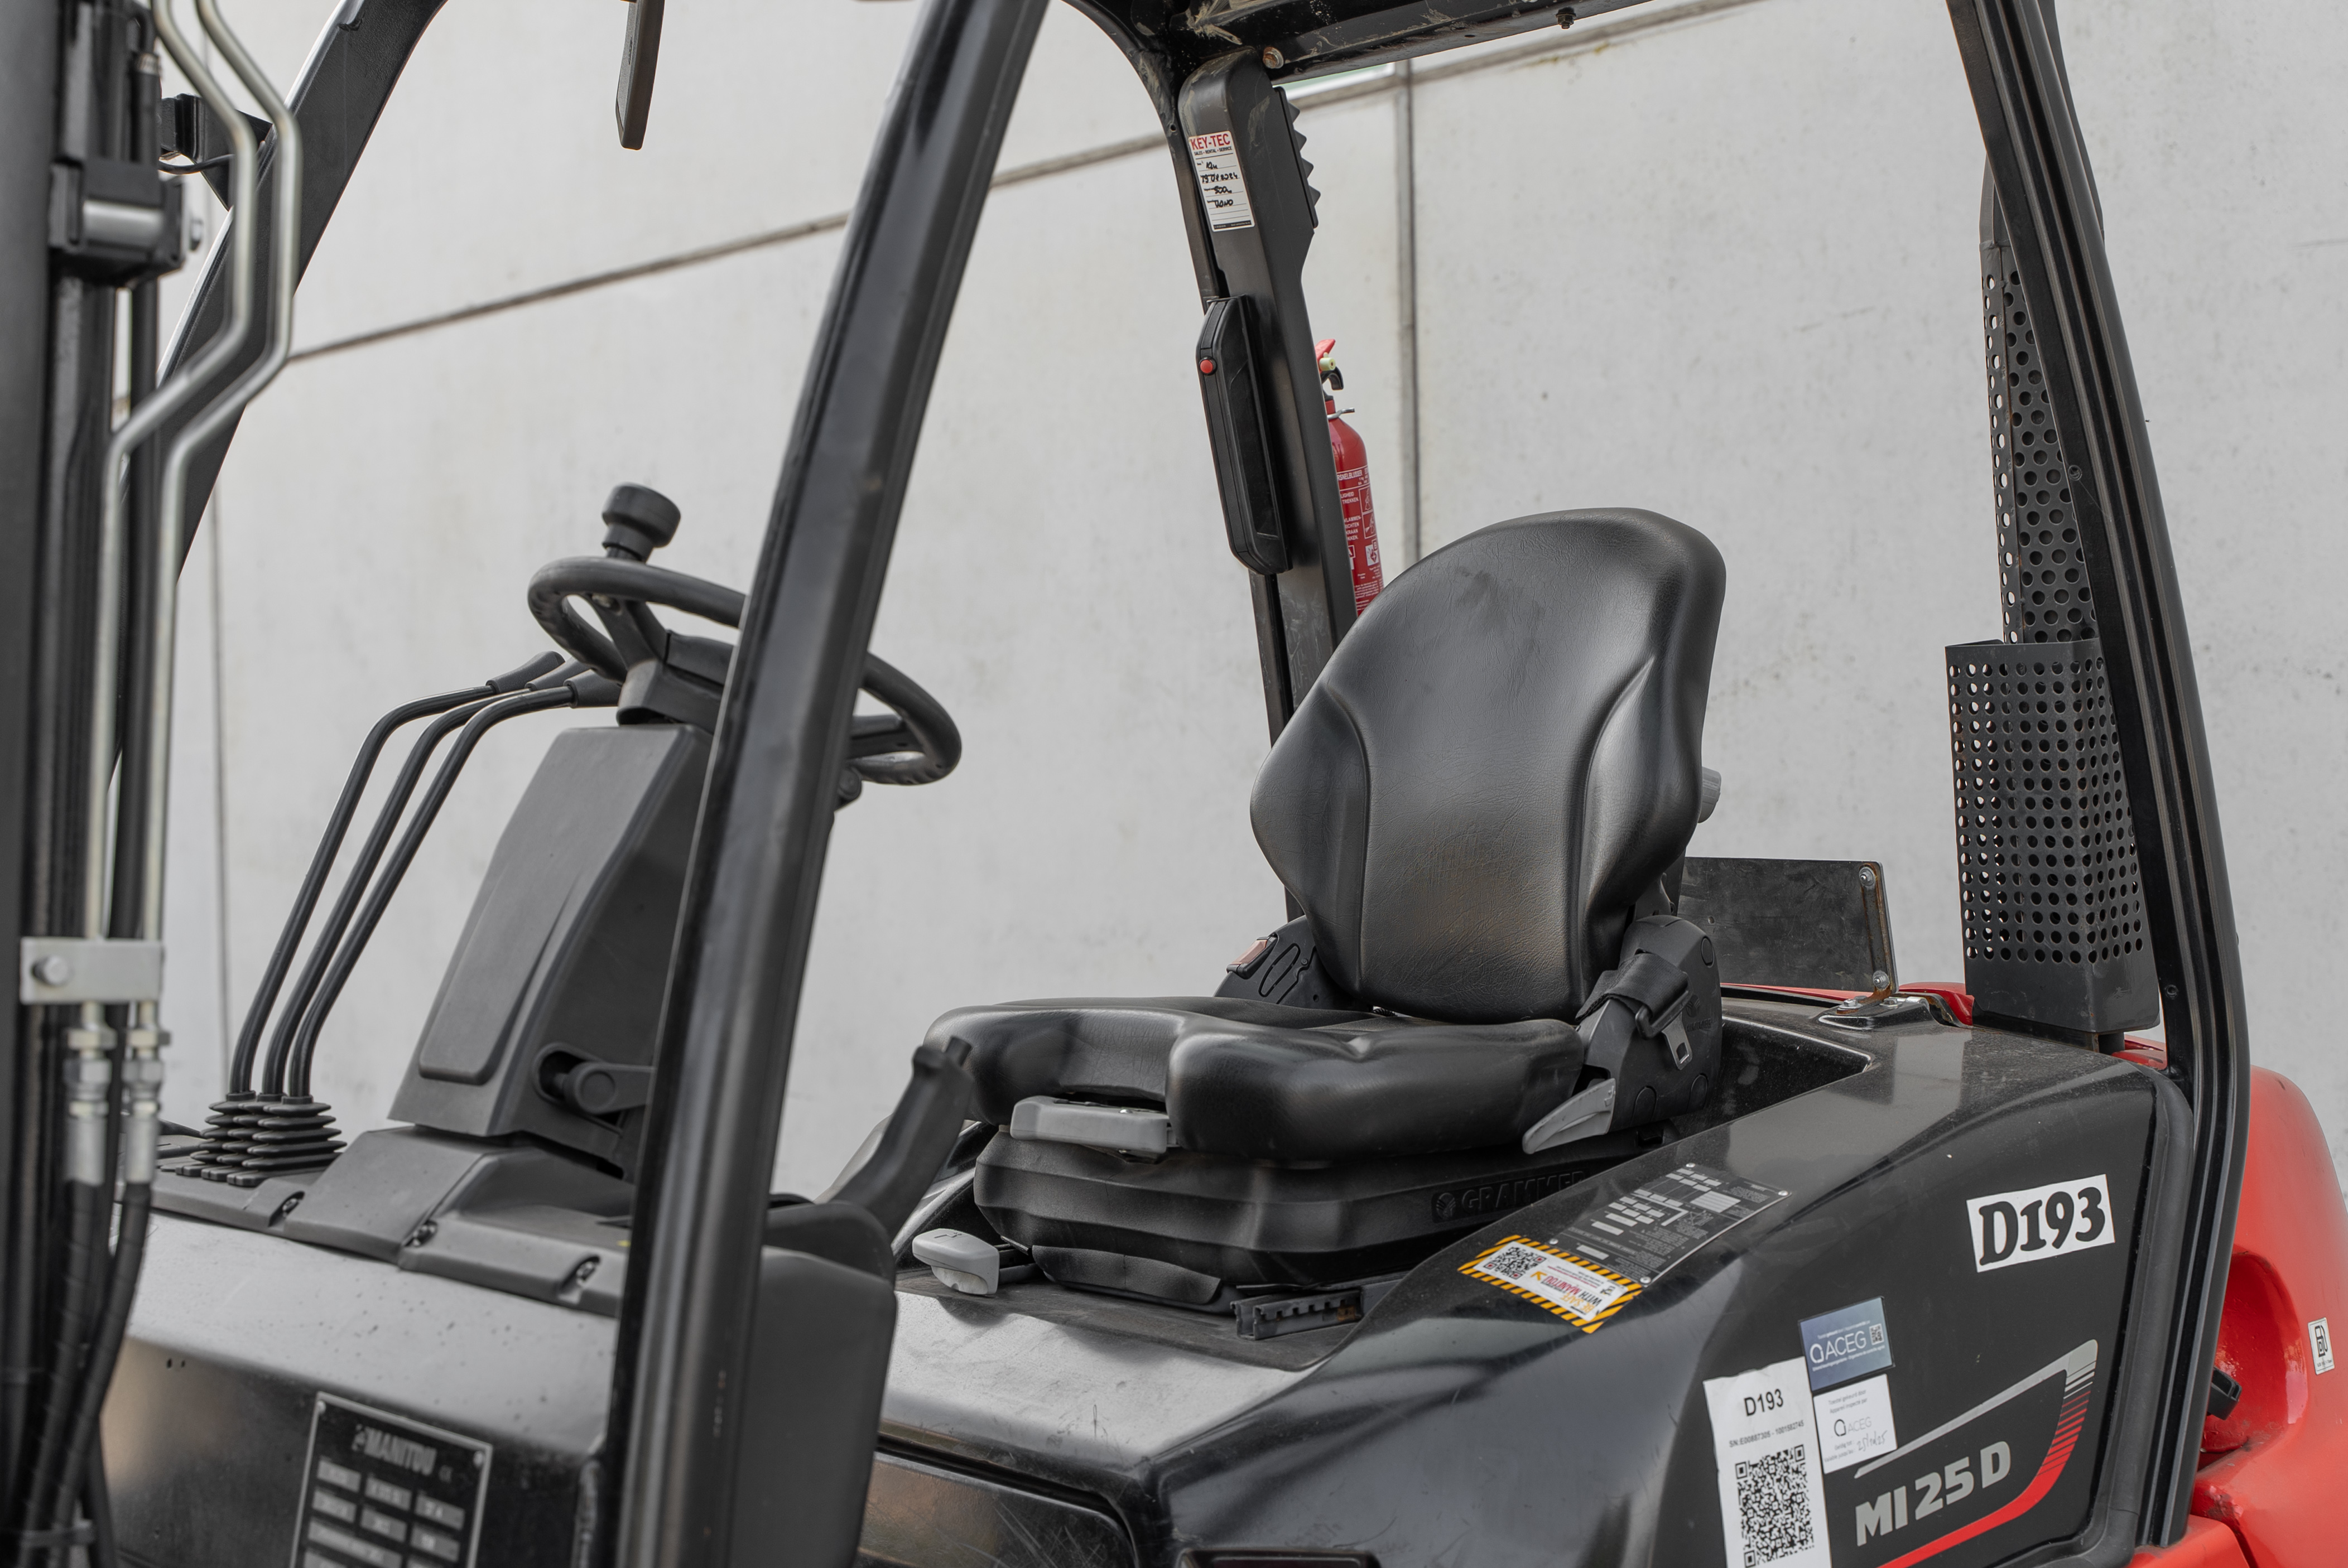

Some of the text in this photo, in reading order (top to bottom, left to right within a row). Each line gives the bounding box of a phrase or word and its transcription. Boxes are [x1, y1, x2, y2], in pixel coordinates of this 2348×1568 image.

[1190, 133, 1230, 151] KEY-TEC
[1978, 1186, 2106, 1266] D193
[1543, 1276, 1581, 1295] MANITOU
[1560, 1292, 1584, 1307] SAFE
[1578, 1291, 1603, 1307] WITH
[1580, 1302, 1596, 1314] BE
[1744, 1388, 1784, 1417] D193
[363, 1425, 438, 1477] MANITOU
[1855, 1440, 2011, 1547] MI 25 D
